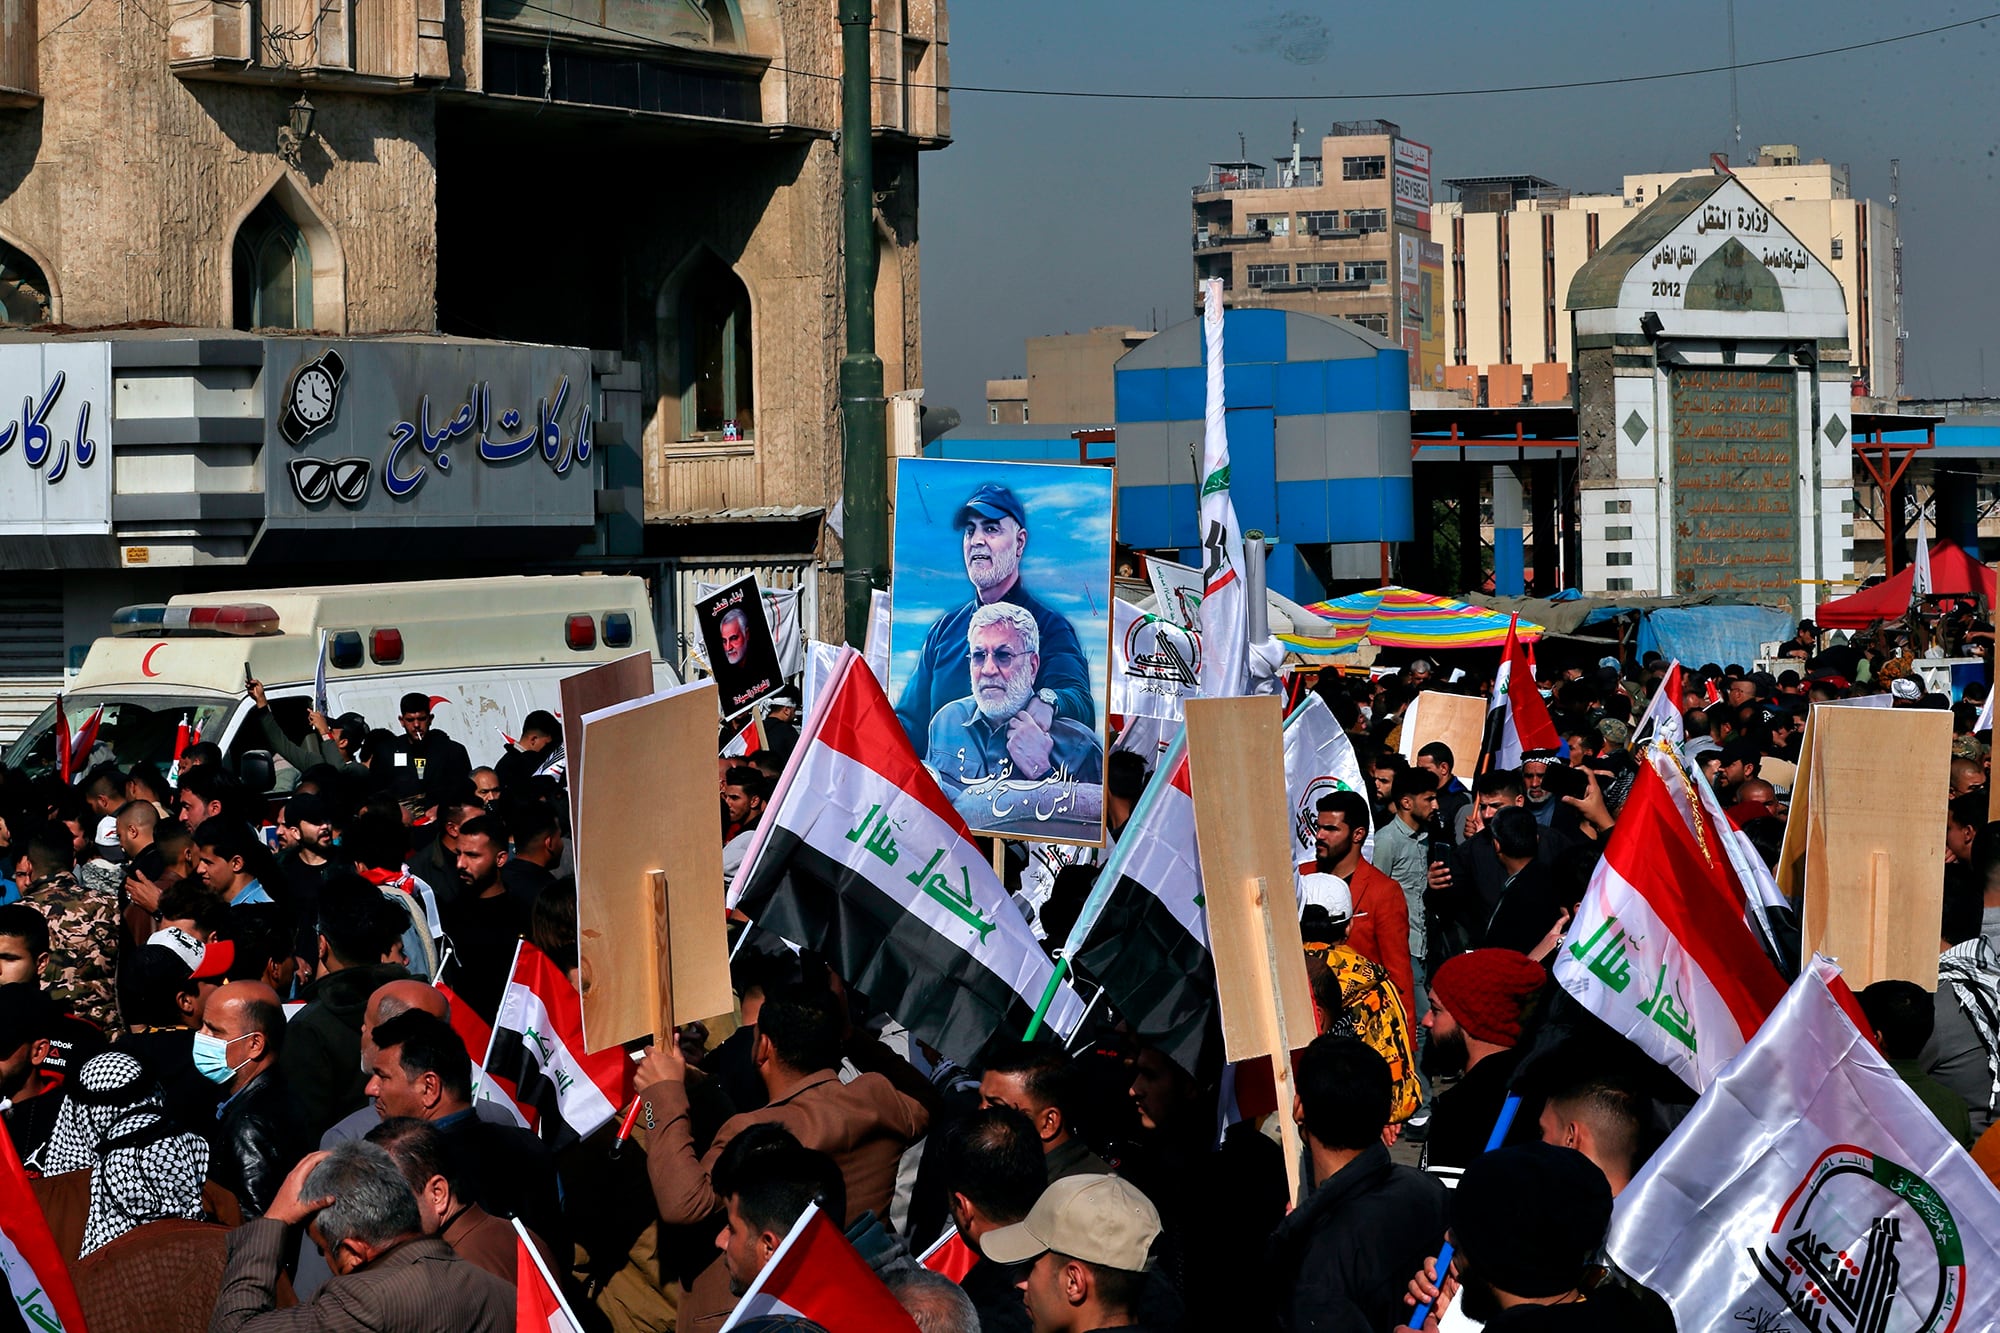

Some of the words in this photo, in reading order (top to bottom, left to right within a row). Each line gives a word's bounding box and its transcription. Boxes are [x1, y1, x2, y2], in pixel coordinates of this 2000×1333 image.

[1396, 177, 1429, 202] EASYSEAL
[1697, 204, 1732, 235] النقل
[1737, 206, 1769, 233] وزارة
[1652, 244, 1677, 271] الخاص
[1676, 244, 1697, 271] النقل
[1763, 247, 1785, 269] العامة
[1784, 248, 1810, 275] الشركة
[1652, 281, 1681, 297] 2012
[479, 374, 592, 473] ماركات
[382, 379, 490, 496] الصباح
[50, 1039, 73, 1050] ebok
[43, 1057, 67, 1067] rossFit
[554, 1066, 574, 1097] الله
[1810, 1157, 1835, 1190] اكبر
[1838, 1155, 1867, 1168] الله
